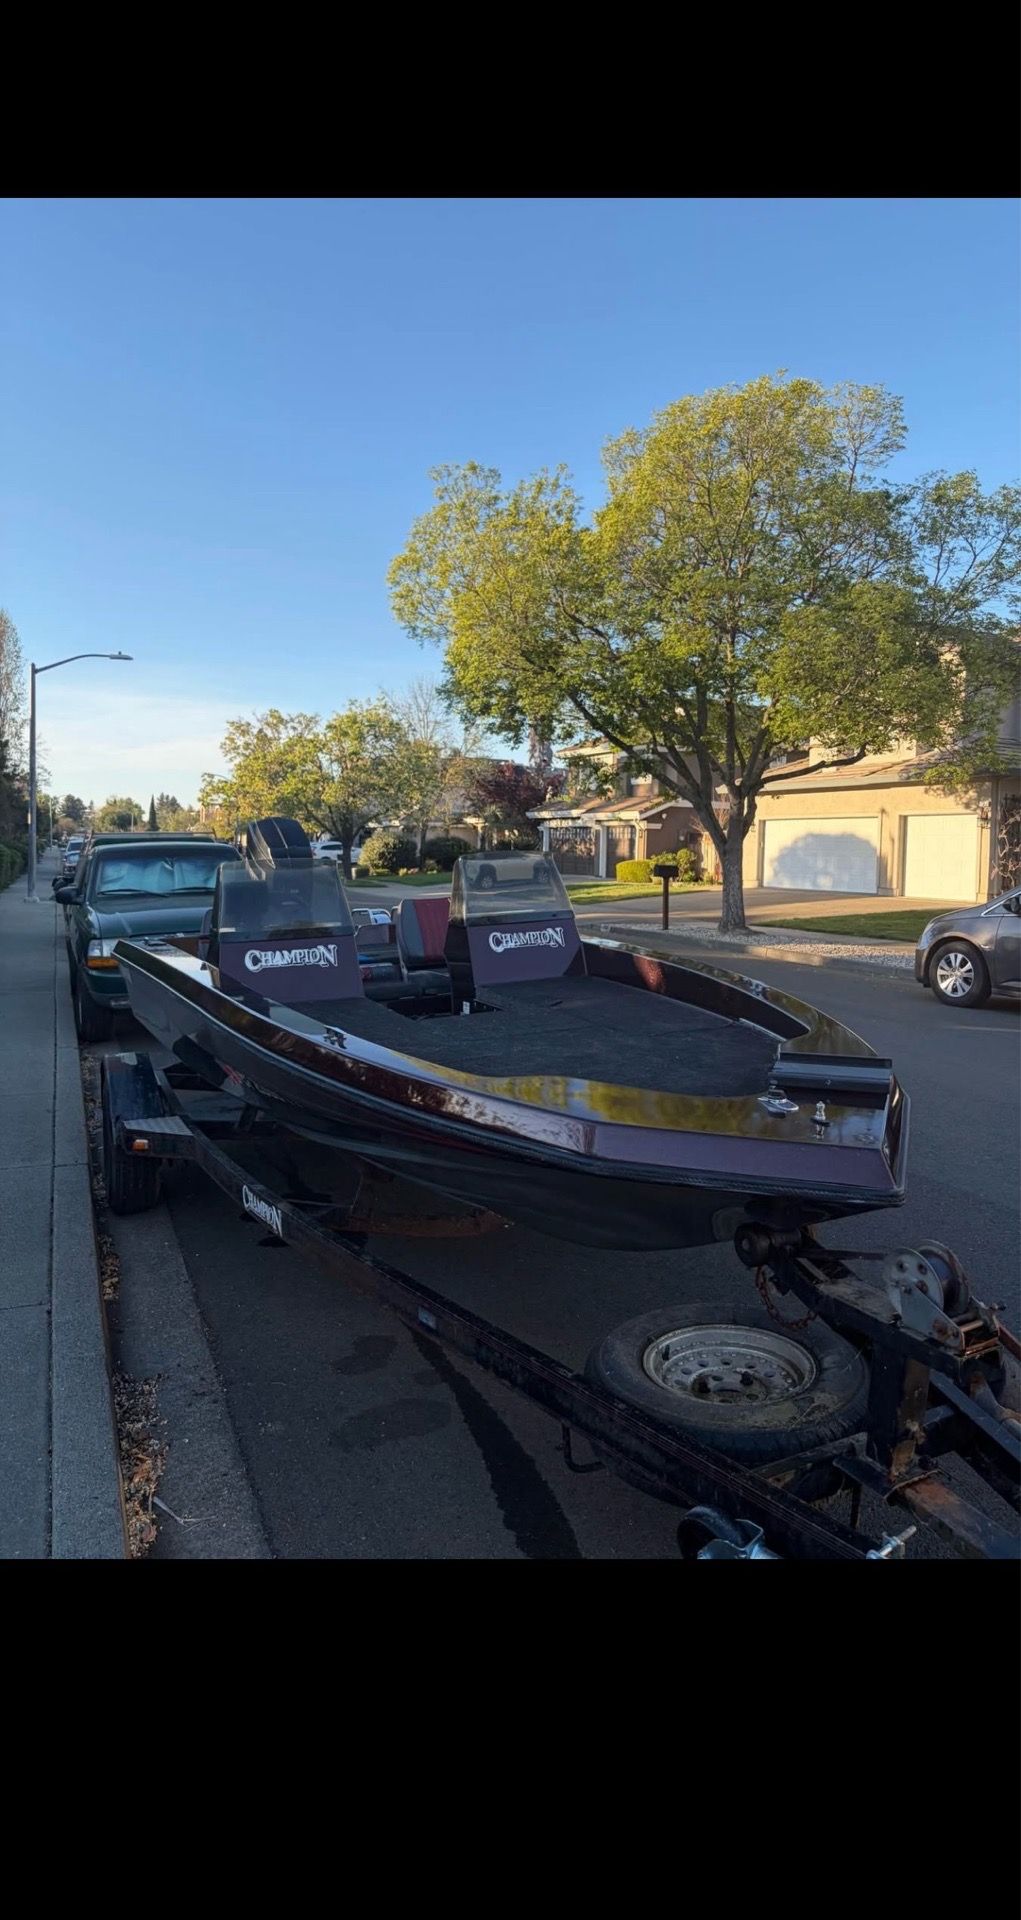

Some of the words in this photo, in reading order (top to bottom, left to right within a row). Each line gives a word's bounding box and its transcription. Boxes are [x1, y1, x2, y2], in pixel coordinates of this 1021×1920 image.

[488, 927, 566, 953] CHAMPION
[244, 944, 338, 973] CHAMPION
[242, 1185, 283, 1238] CHAMPION
